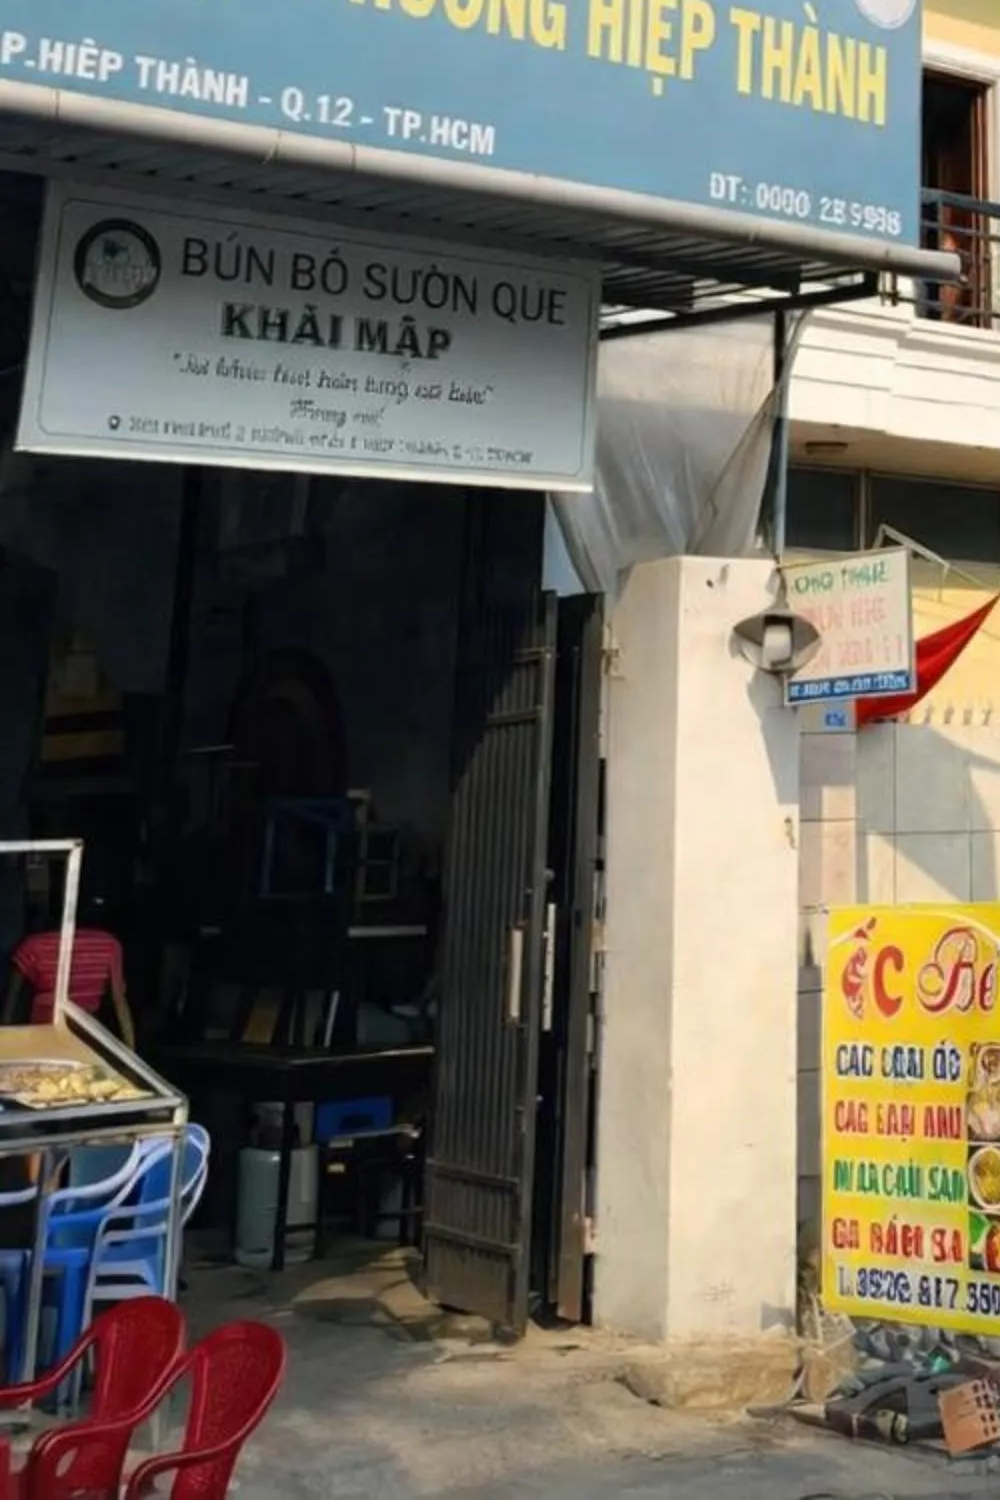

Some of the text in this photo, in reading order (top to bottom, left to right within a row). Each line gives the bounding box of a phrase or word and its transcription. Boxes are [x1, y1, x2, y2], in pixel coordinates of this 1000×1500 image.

[729, 1, 888, 127] THÀNH
[280, 86, 354, 128] Q.12
[383, 106, 497, 156] TP.HCM
[182, 232, 274, 287] BÚN
